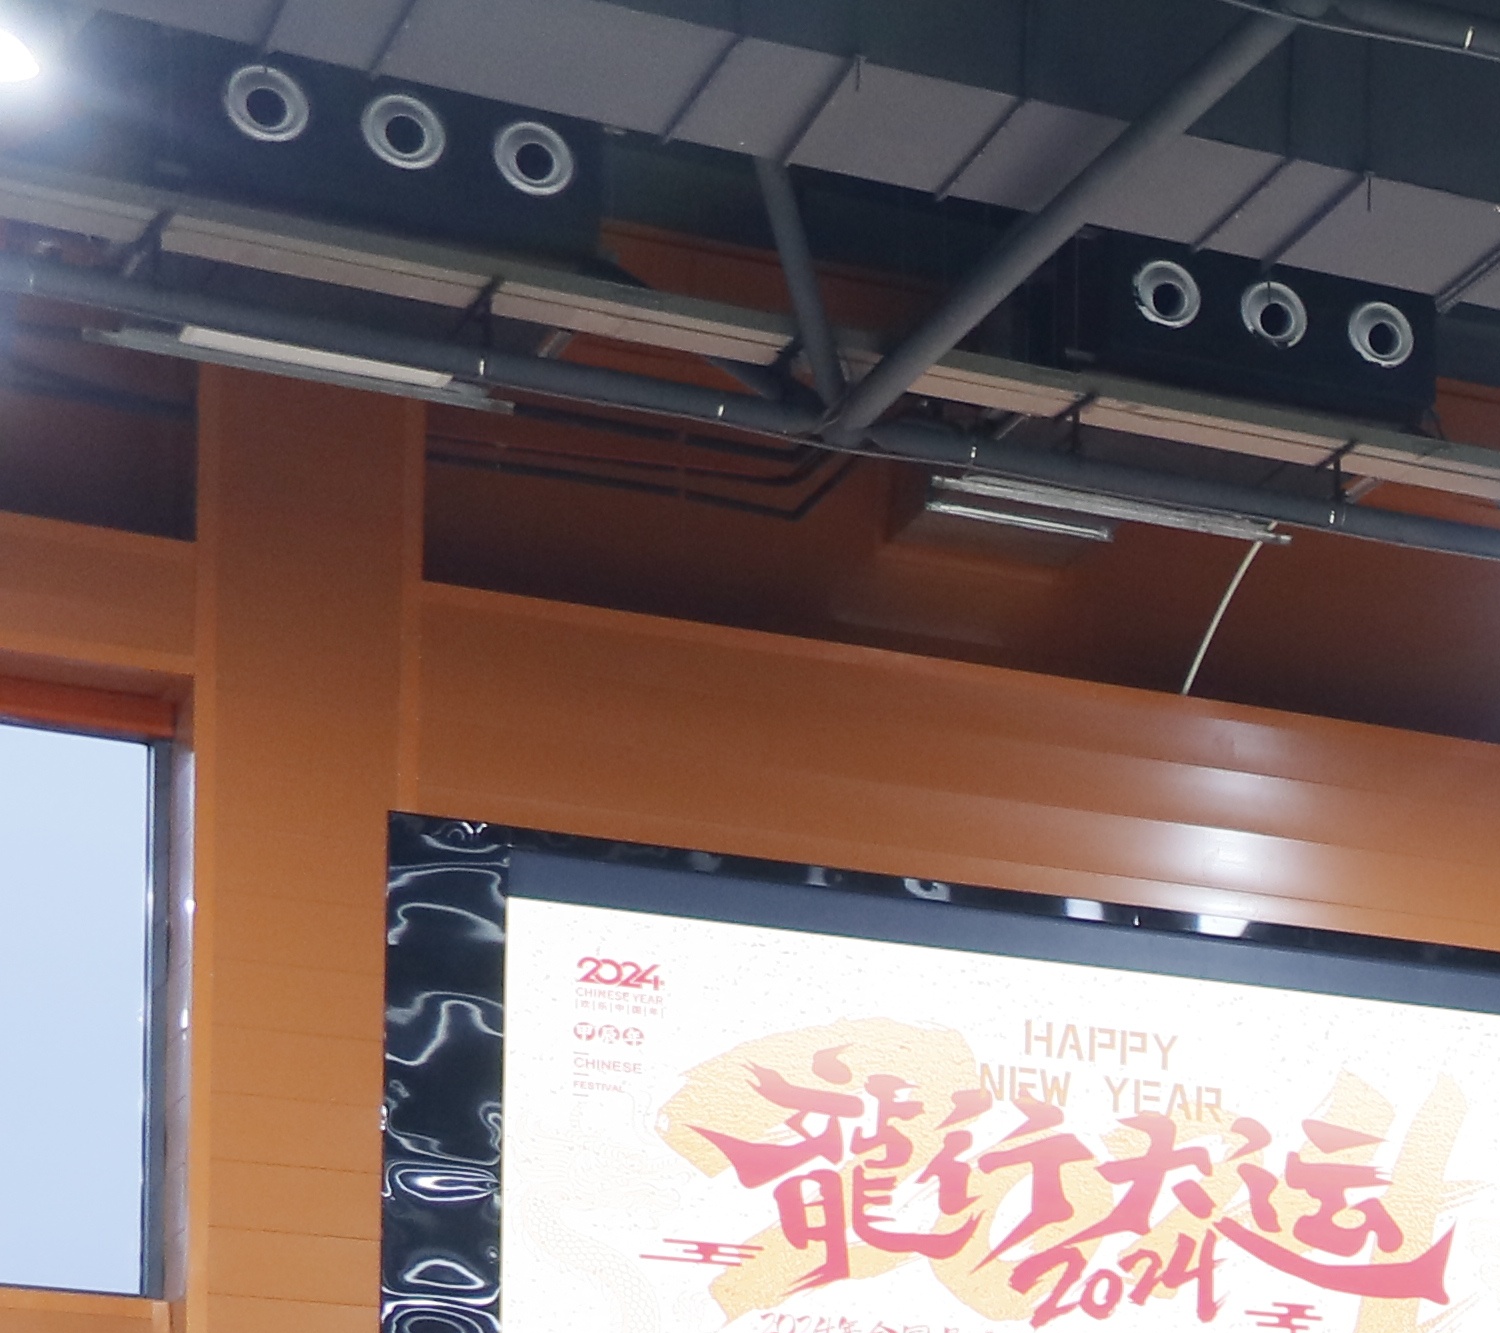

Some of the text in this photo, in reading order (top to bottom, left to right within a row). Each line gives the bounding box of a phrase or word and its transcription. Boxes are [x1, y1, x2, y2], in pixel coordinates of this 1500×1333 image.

[576, 956, 665, 991] 2024
[575, 986, 664, 1005] CHINESE YEAR
[1024, 1018, 1179, 1073] HAPPY
[573, 1057, 643, 1074] CHINESE
[573, 1080, 625, 1093] FESTIVAL
[981, 1062, 1224, 1123] NEW YEAR
[1012, 1221, 1229, 1329] 2024
